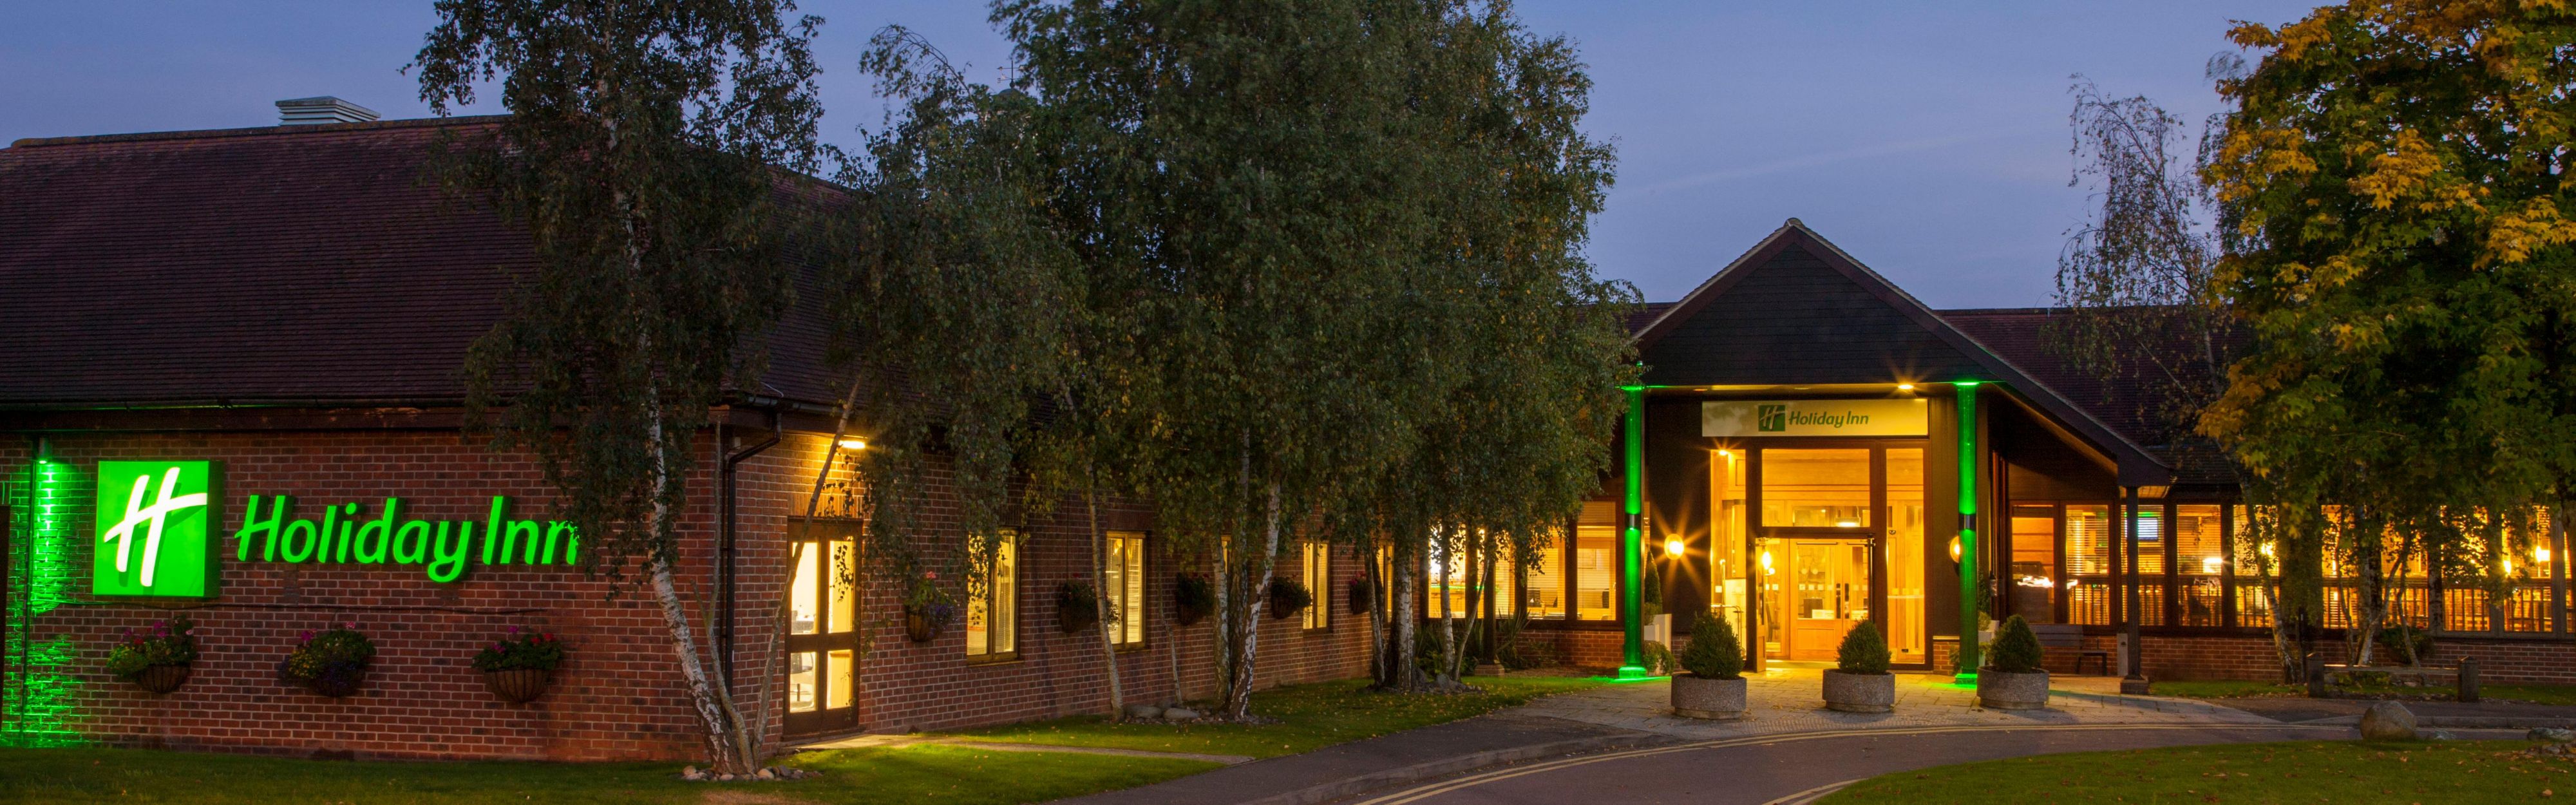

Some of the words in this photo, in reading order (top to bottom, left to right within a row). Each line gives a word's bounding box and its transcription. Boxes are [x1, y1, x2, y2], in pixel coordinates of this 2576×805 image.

[1788, 411, 1844, 428] Holiday
[1846, 411, 1869, 424] Inn
[234, 495, 472, 583] Holiday
[482, 495, 580, 565] Inn
